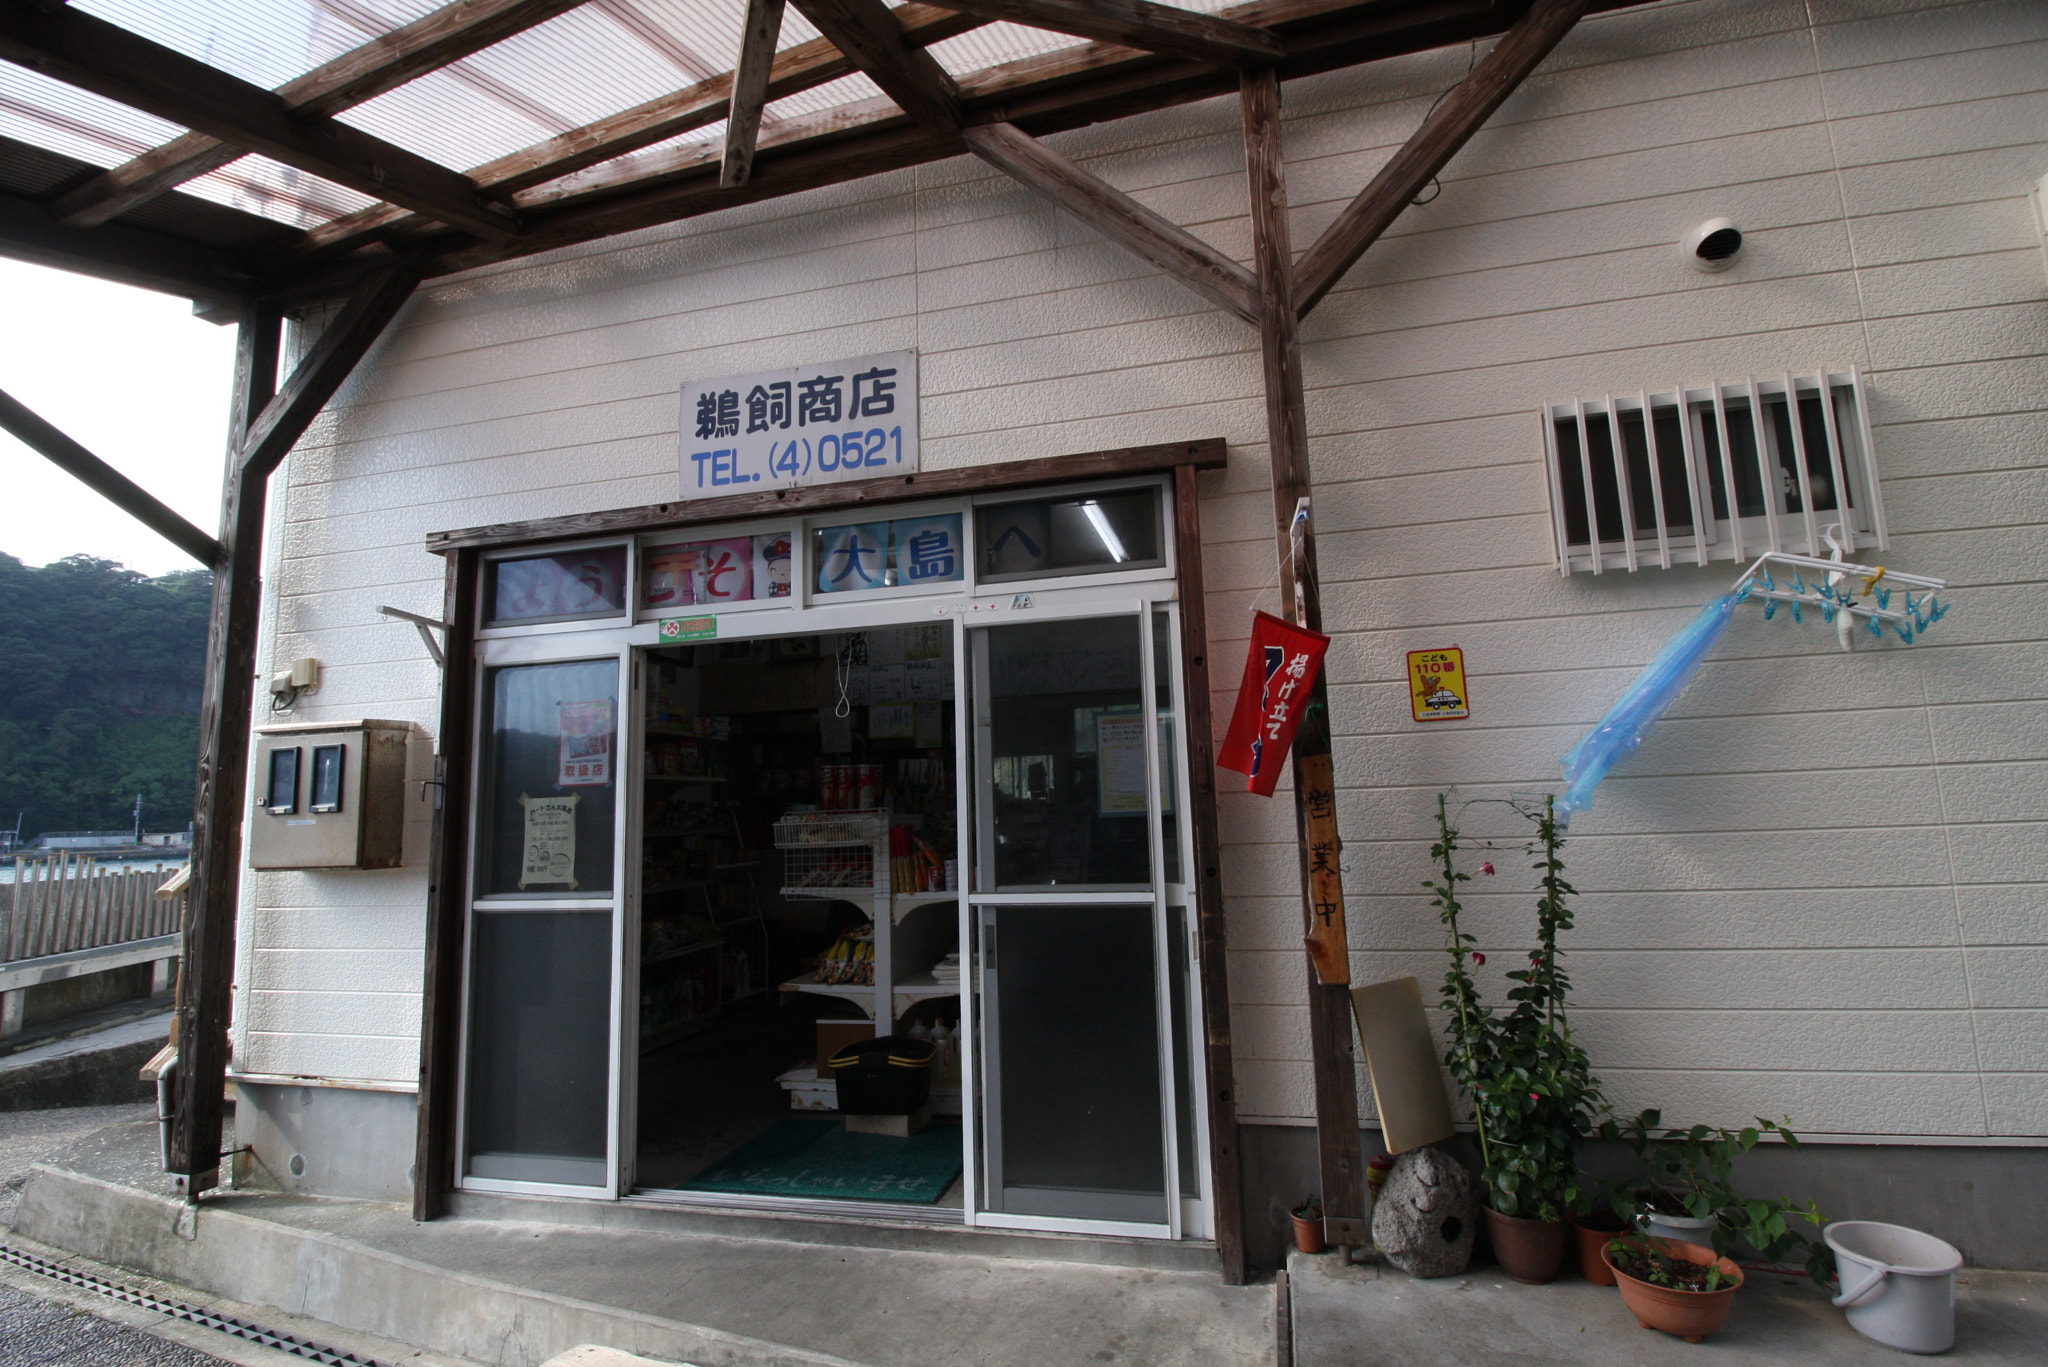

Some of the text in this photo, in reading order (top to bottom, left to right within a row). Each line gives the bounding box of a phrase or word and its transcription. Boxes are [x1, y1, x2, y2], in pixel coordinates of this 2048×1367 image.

[695, 367, 898, 440] 鵜飼商店
[1416, 662, 1456, 674] 110番
[1421, 654, 1448, 662] こども
[1266, 653, 1310, 740] 揚げ立て
[565, 763, 604, 777] 取扱店
[1308, 791, 1338, 928] 営業中
